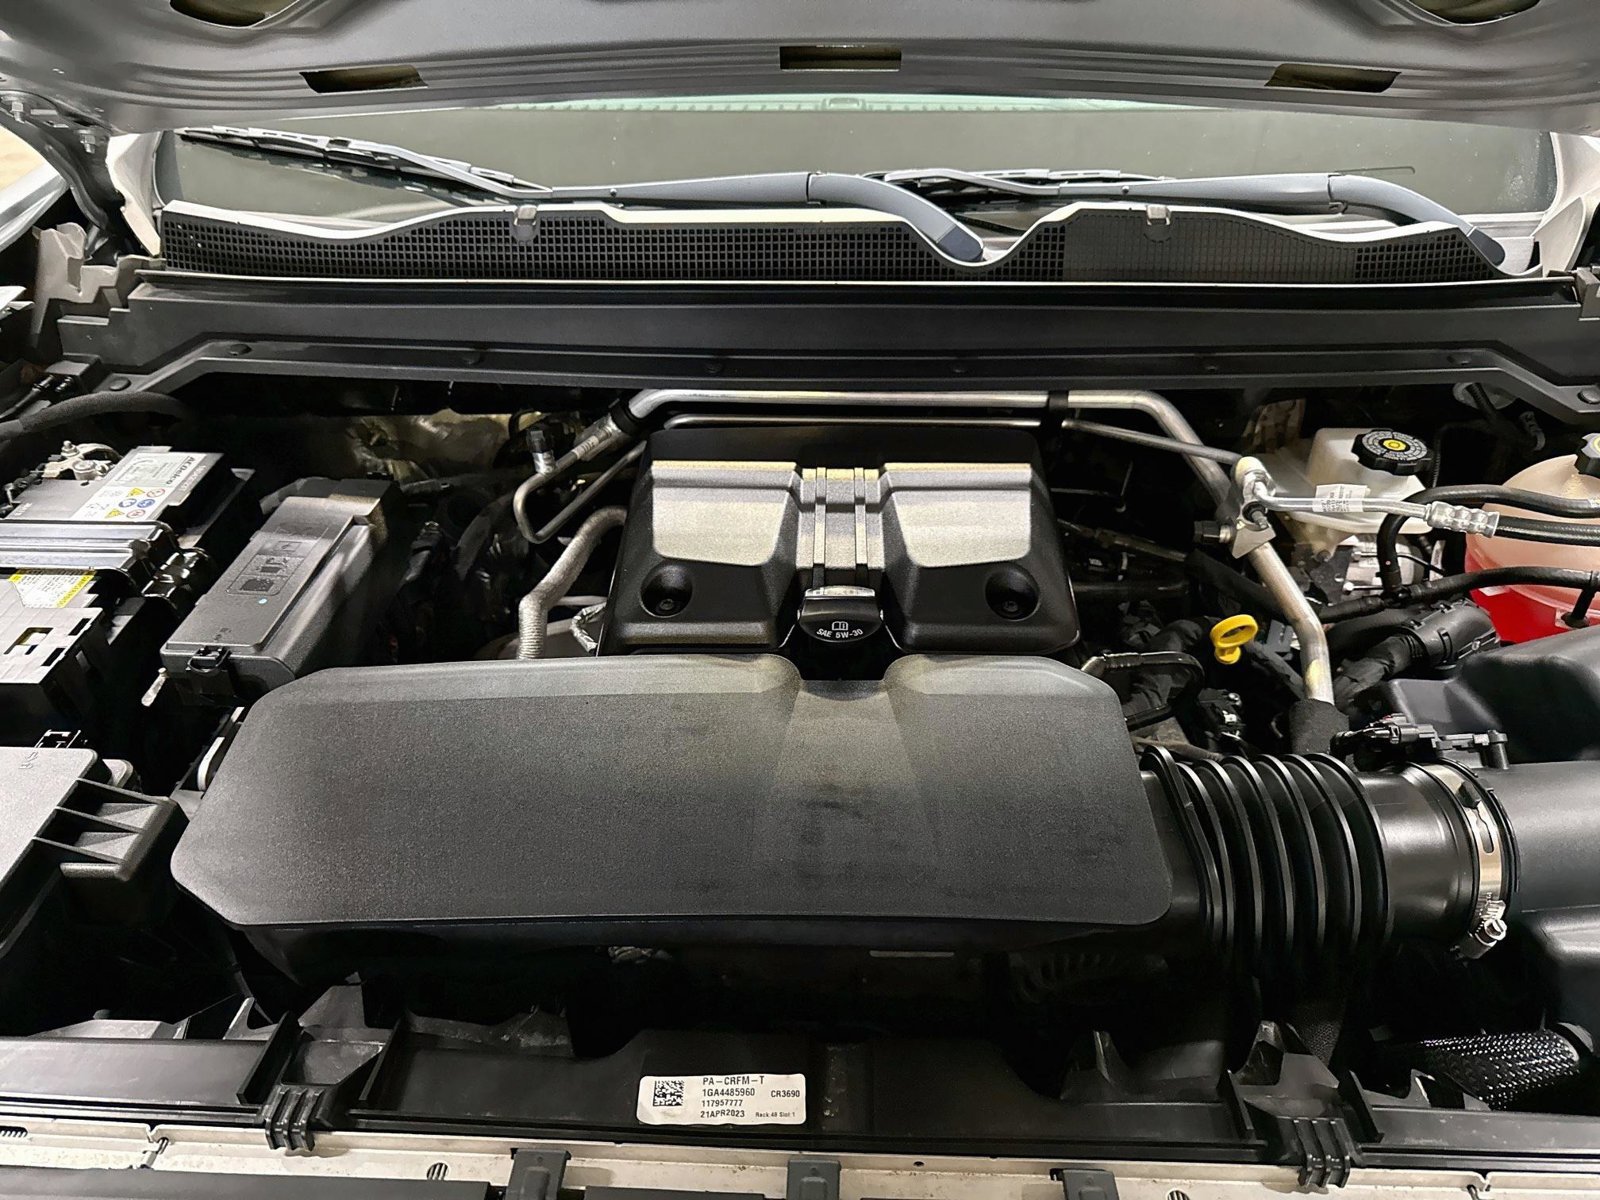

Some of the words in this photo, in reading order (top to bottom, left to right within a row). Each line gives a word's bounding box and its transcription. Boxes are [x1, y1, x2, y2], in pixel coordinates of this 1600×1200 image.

[166, 456, 197, 485] ACDelco
[816, 628, 832, 637] SAE
[835, 628, 863, 638] 5W-30
[702, 1076, 765, 1085] PA-CRFM-T
[702, 1088, 756, 1097] 1GA4485960
[770, 1090, 800, 1098] CR3690
[701, 1099, 743, 1107] 117957777
[700, 1109, 745, 1118] 21APR2023
